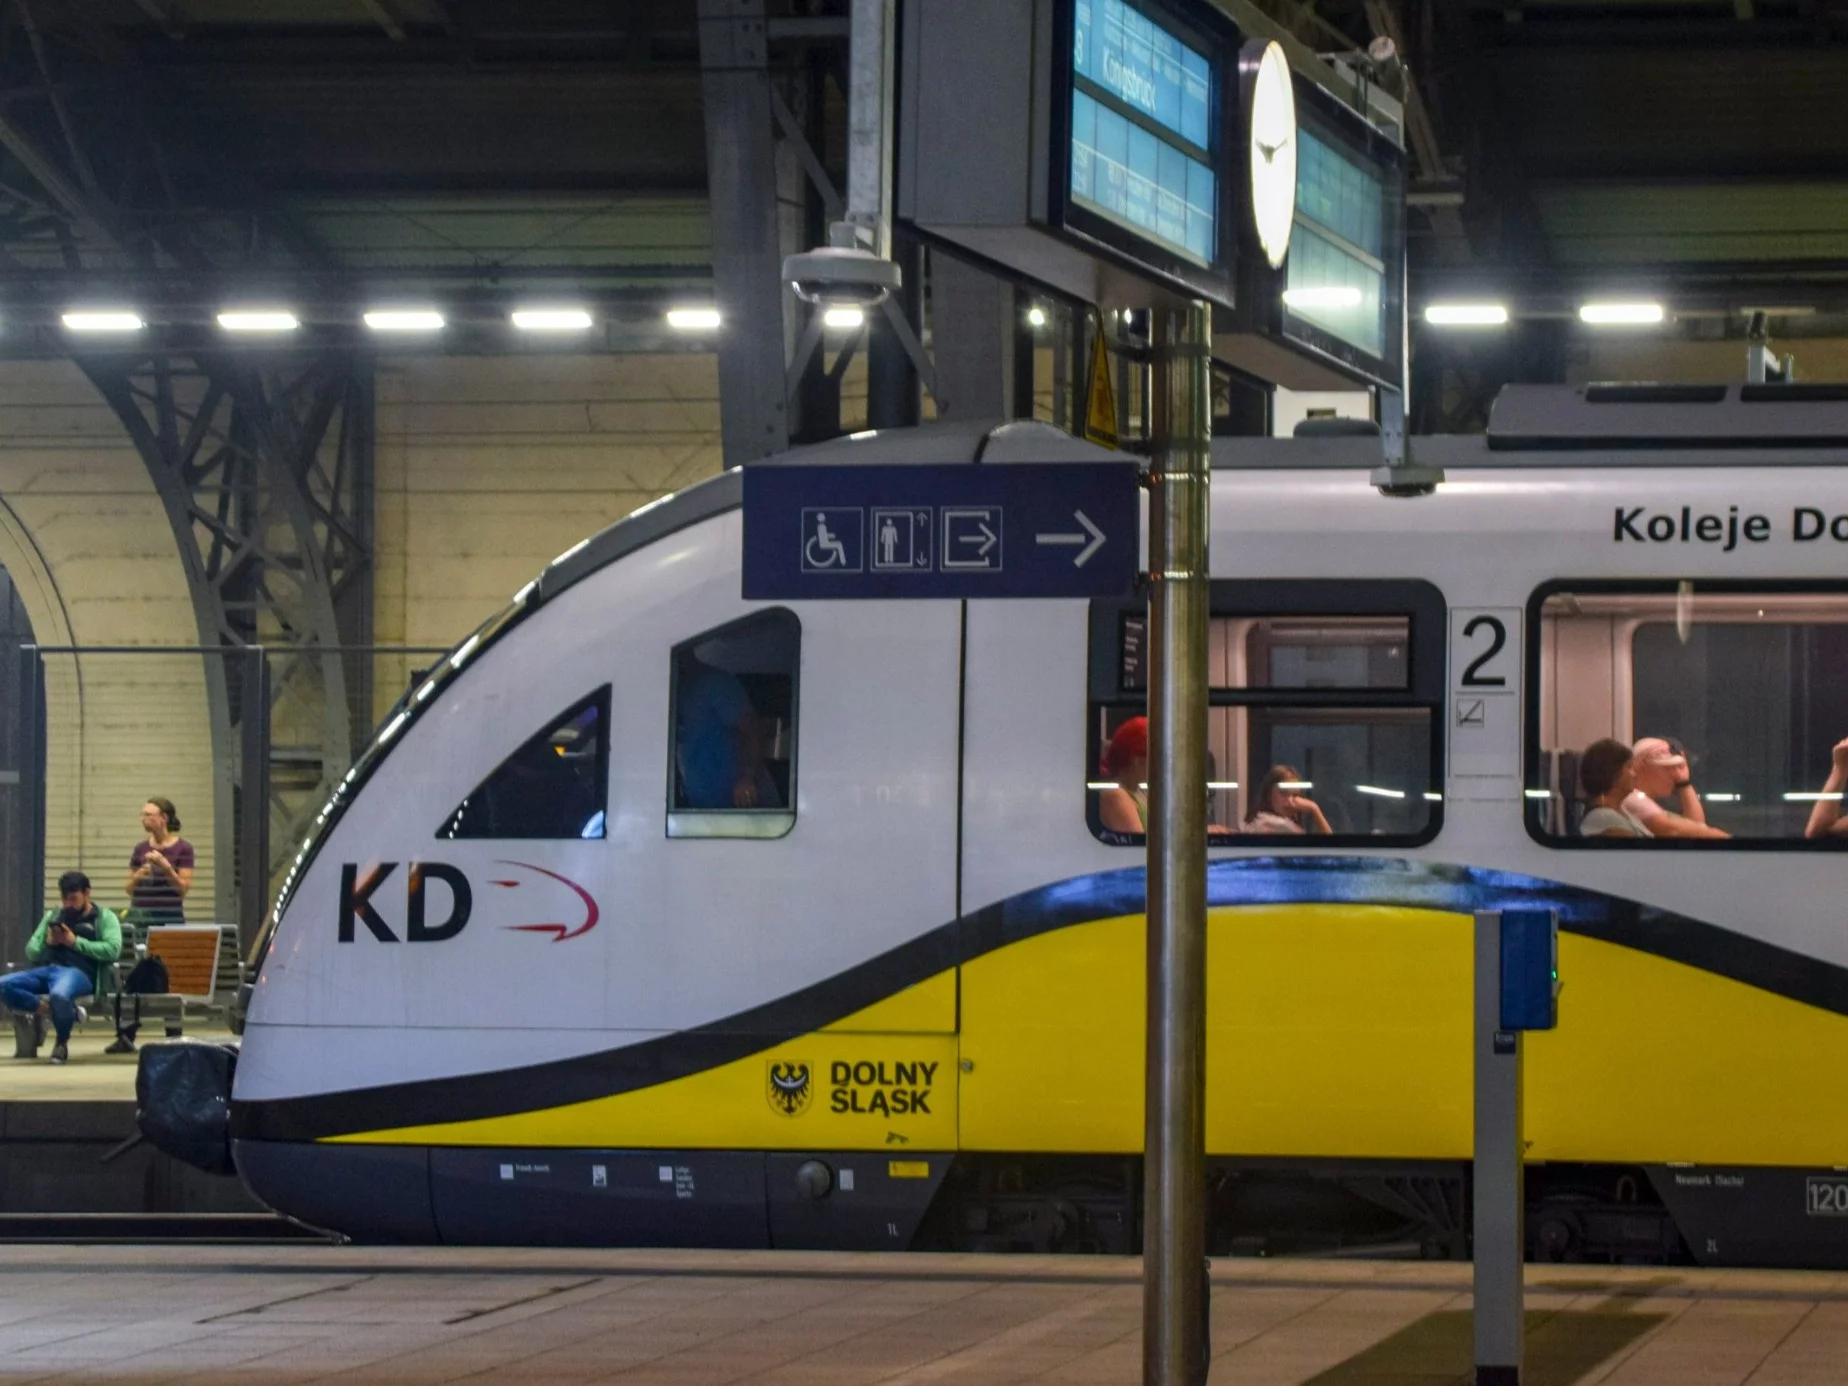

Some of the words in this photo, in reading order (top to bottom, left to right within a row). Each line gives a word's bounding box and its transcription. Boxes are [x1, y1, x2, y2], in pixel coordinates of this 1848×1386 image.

[1613, 505, 1771, 552] Koleje
[1793, 507, 1848, 542] Do
[1461, 615, 1507, 687] 2
[338, 861, 473, 943] KD
[830, 1060, 939, 1086] DOLNY
